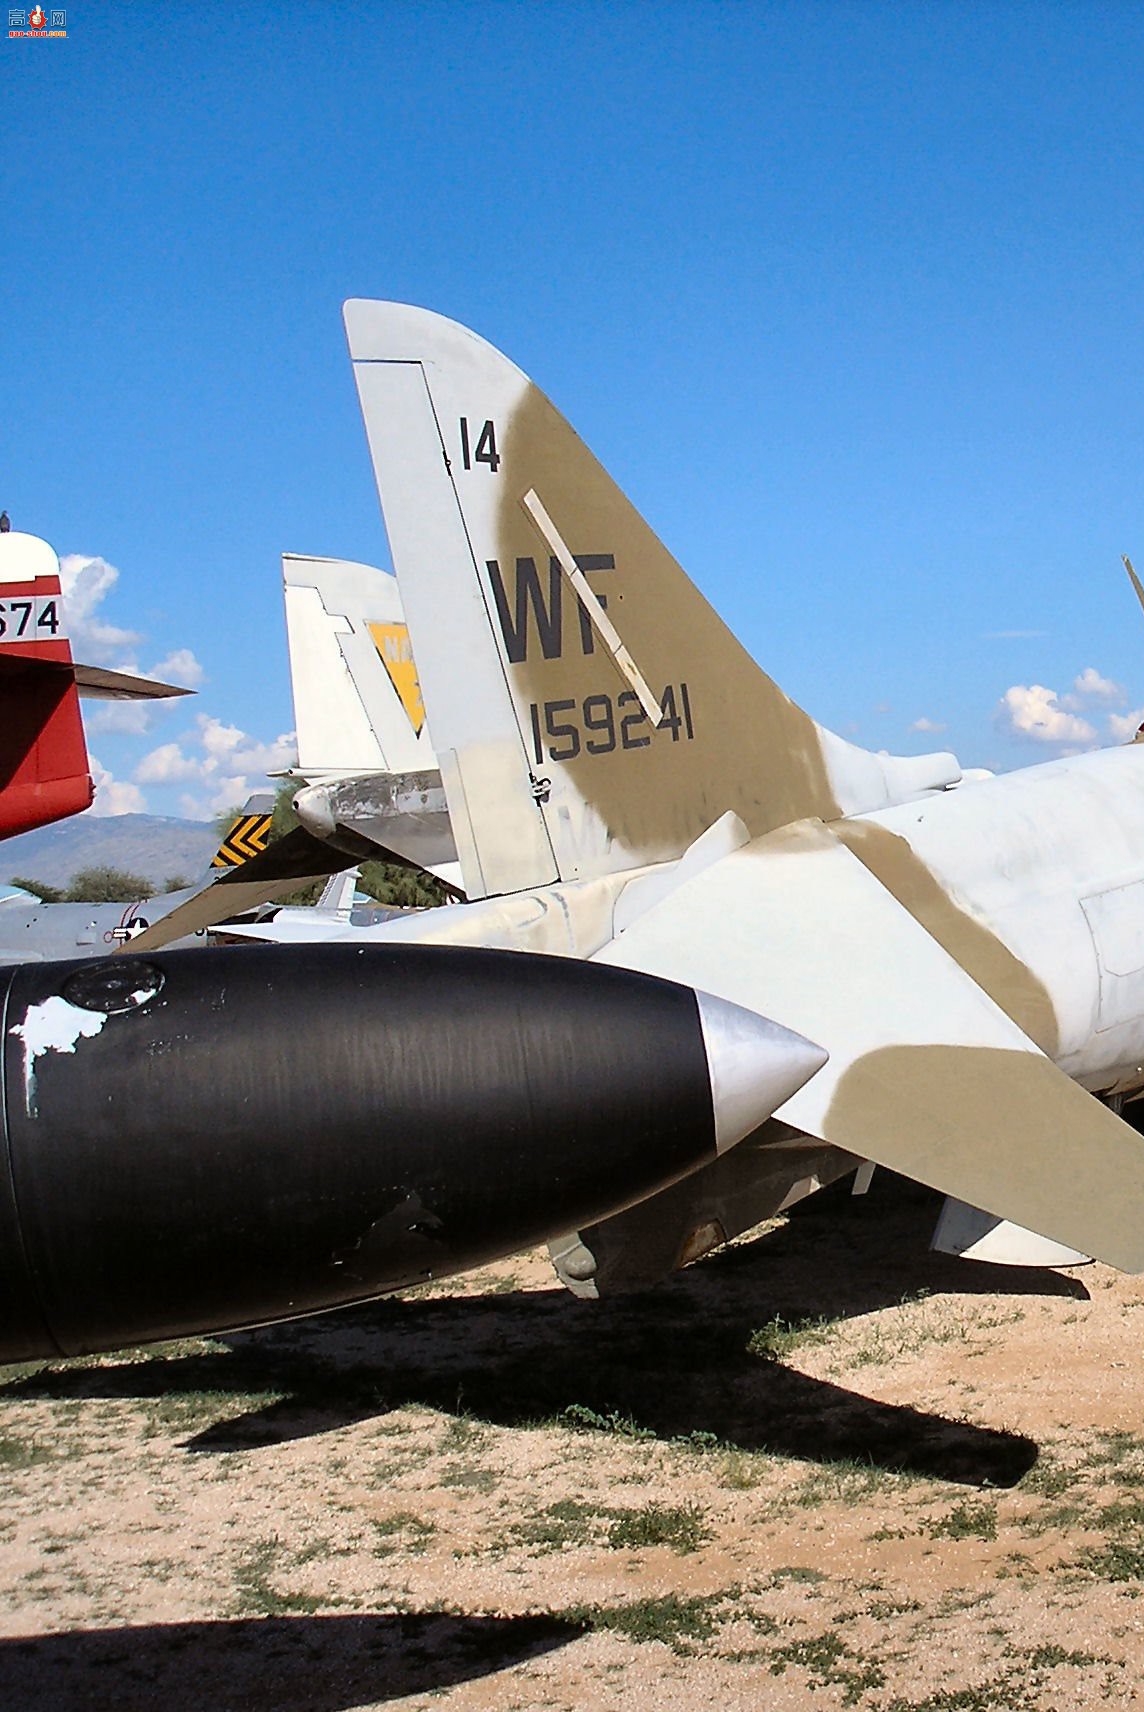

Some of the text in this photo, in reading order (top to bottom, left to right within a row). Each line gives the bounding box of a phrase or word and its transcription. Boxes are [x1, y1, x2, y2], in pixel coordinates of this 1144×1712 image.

[460, 417, 501, 473] 14
[485, 554, 616, 665] WF
[530, 682, 695, 766] 159241
